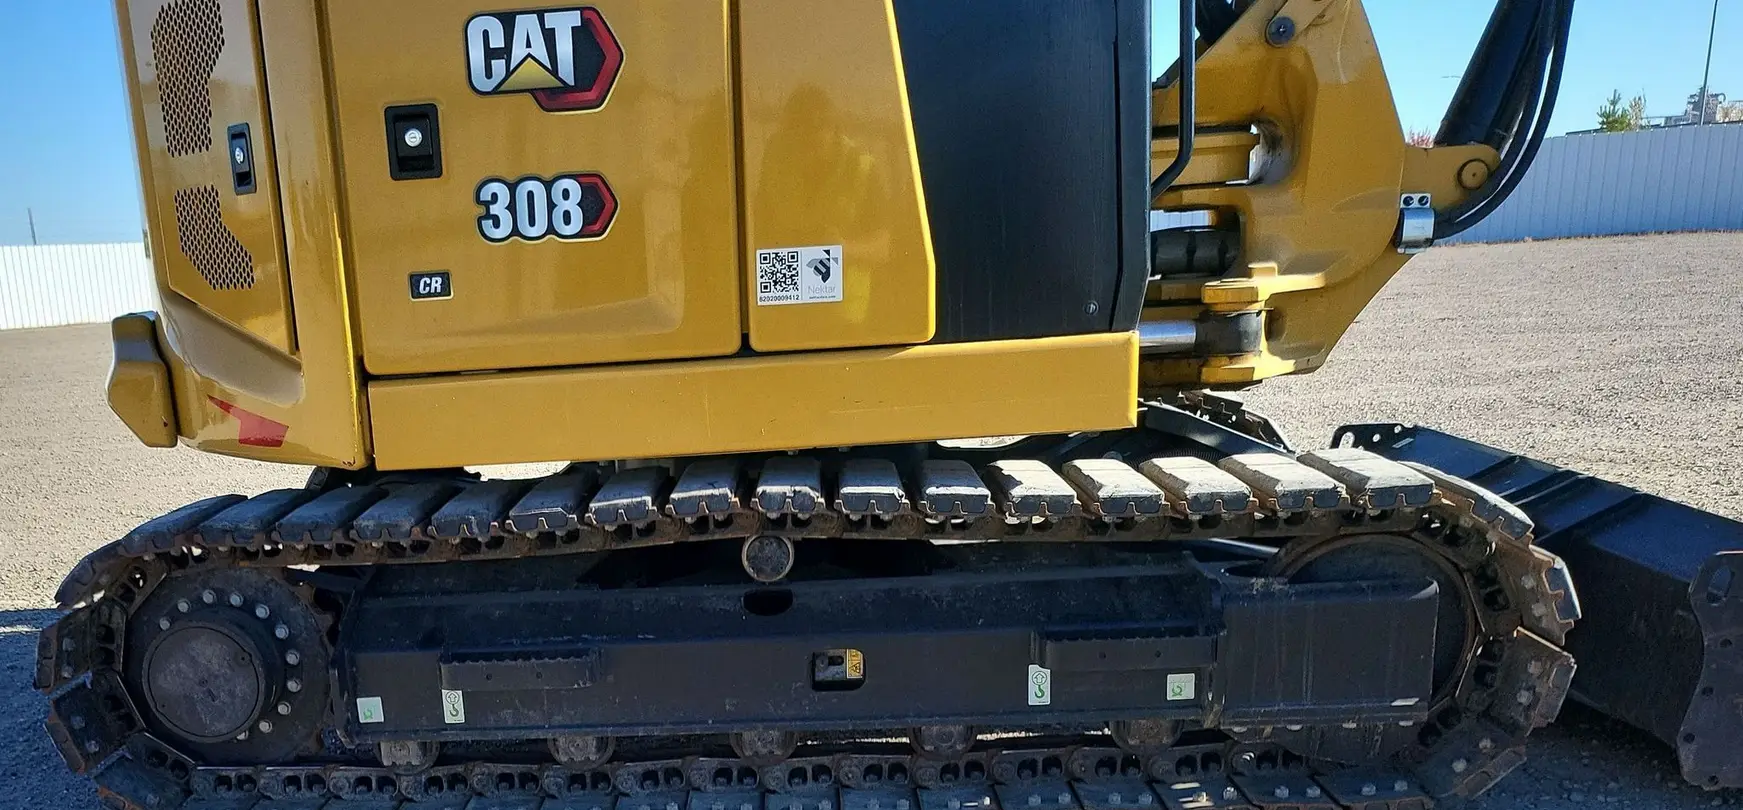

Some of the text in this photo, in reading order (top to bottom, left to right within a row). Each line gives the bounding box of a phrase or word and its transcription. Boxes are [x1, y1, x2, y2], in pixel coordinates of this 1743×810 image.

[467, 10, 582, 92] CAT
[479, 178, 583, 239] 308
[419, 276, 442, 294] CR
[808, 284, 836, 295] Nektar
[759, 294, 800, 303] 82020009412
